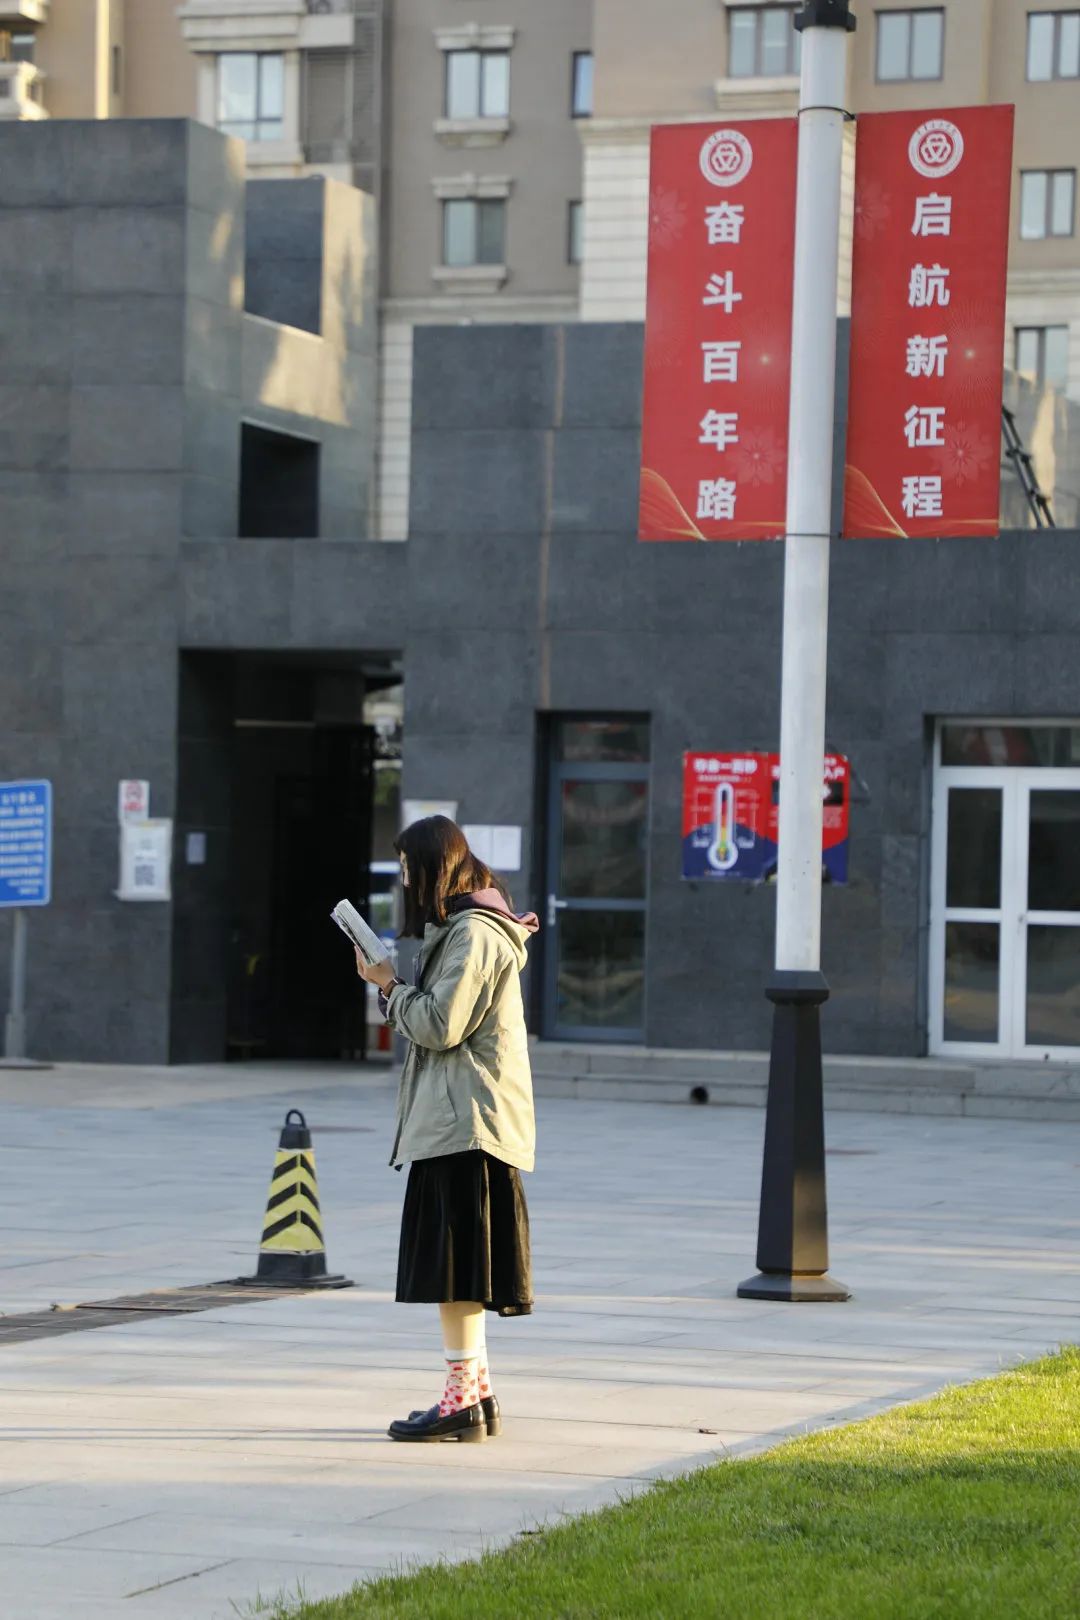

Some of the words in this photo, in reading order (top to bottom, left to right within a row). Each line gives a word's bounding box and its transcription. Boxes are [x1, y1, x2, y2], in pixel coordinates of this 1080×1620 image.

[696, 201, 745, 520] 奋斗百年路
[901, 193, 952, 518] 启航新征程
